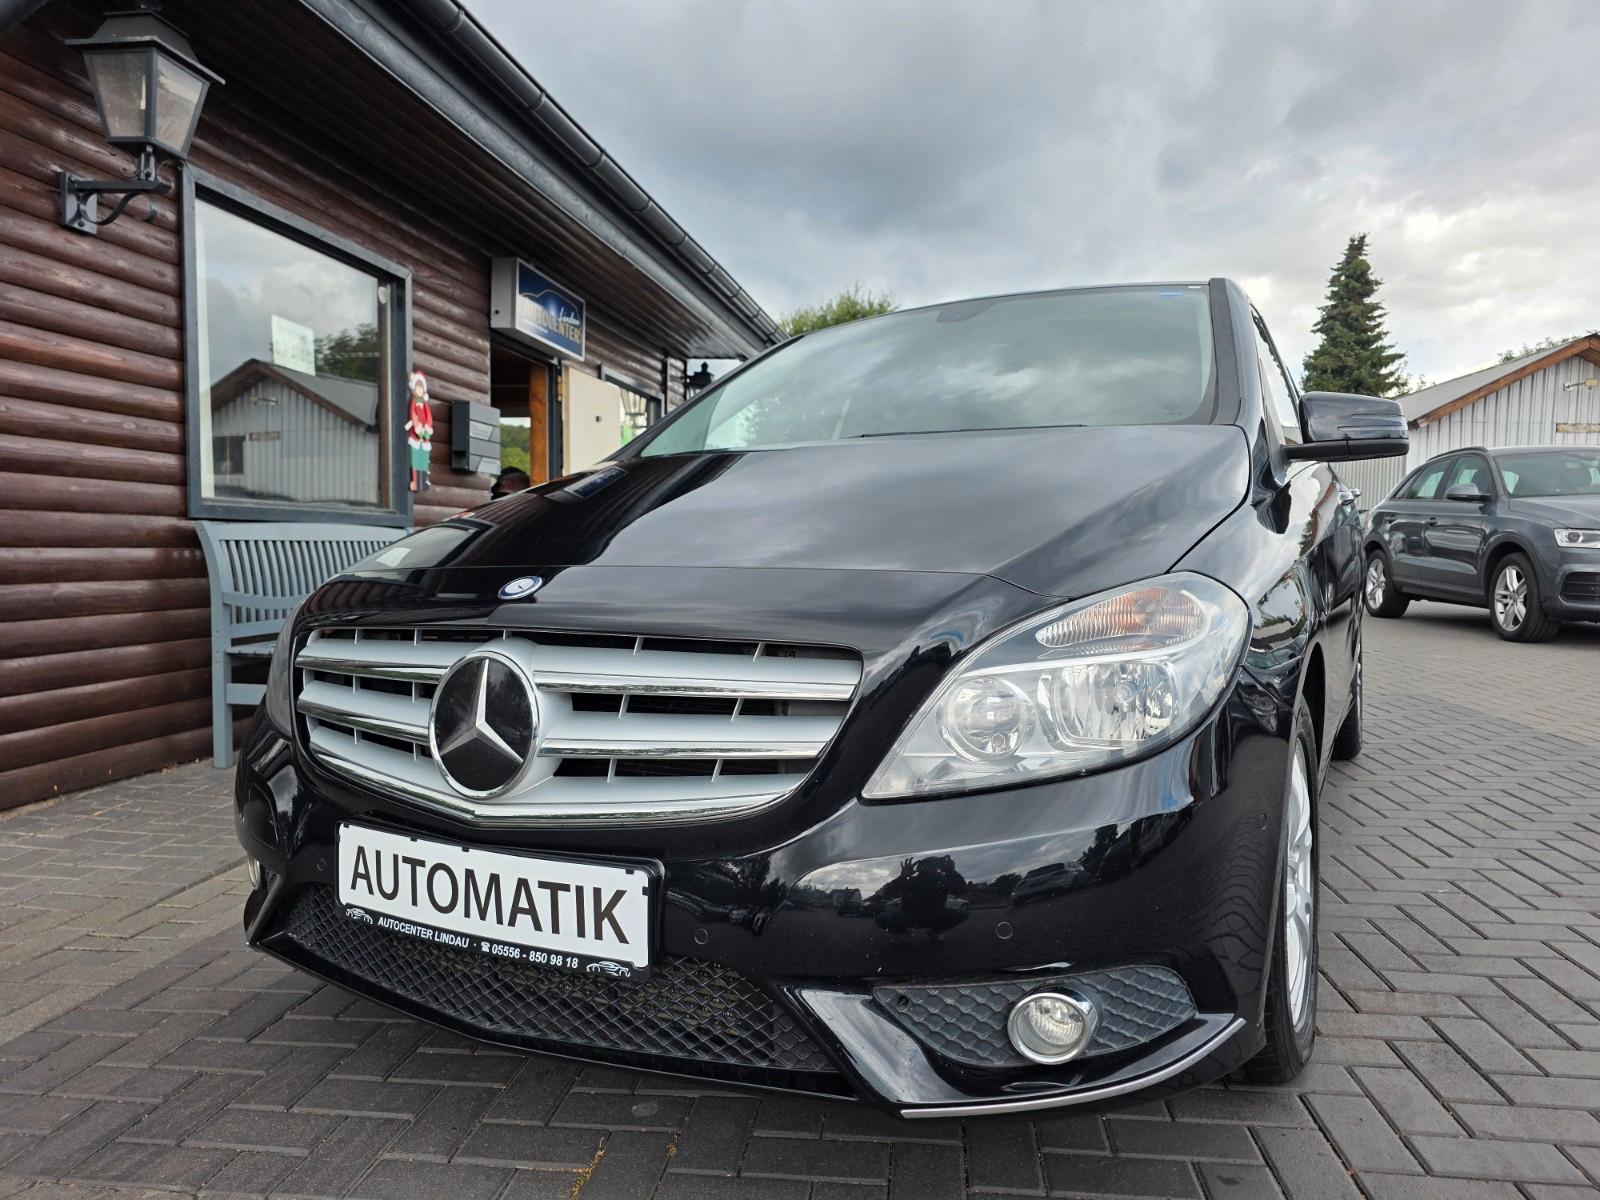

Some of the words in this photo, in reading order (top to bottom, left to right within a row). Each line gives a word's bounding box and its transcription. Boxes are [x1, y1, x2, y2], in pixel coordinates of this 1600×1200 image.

[350, 845, 630, 945] AUTOMATIK
[377, 916, 433, 940] AUTOCENTER
[434, 930, 469, 948] LINDAU
[491, 943, 520, 959] 05556
[529, 950, 548, 964] 850
[549, 954, 563, 966] 98
[565, 956, 579, 969] 18
